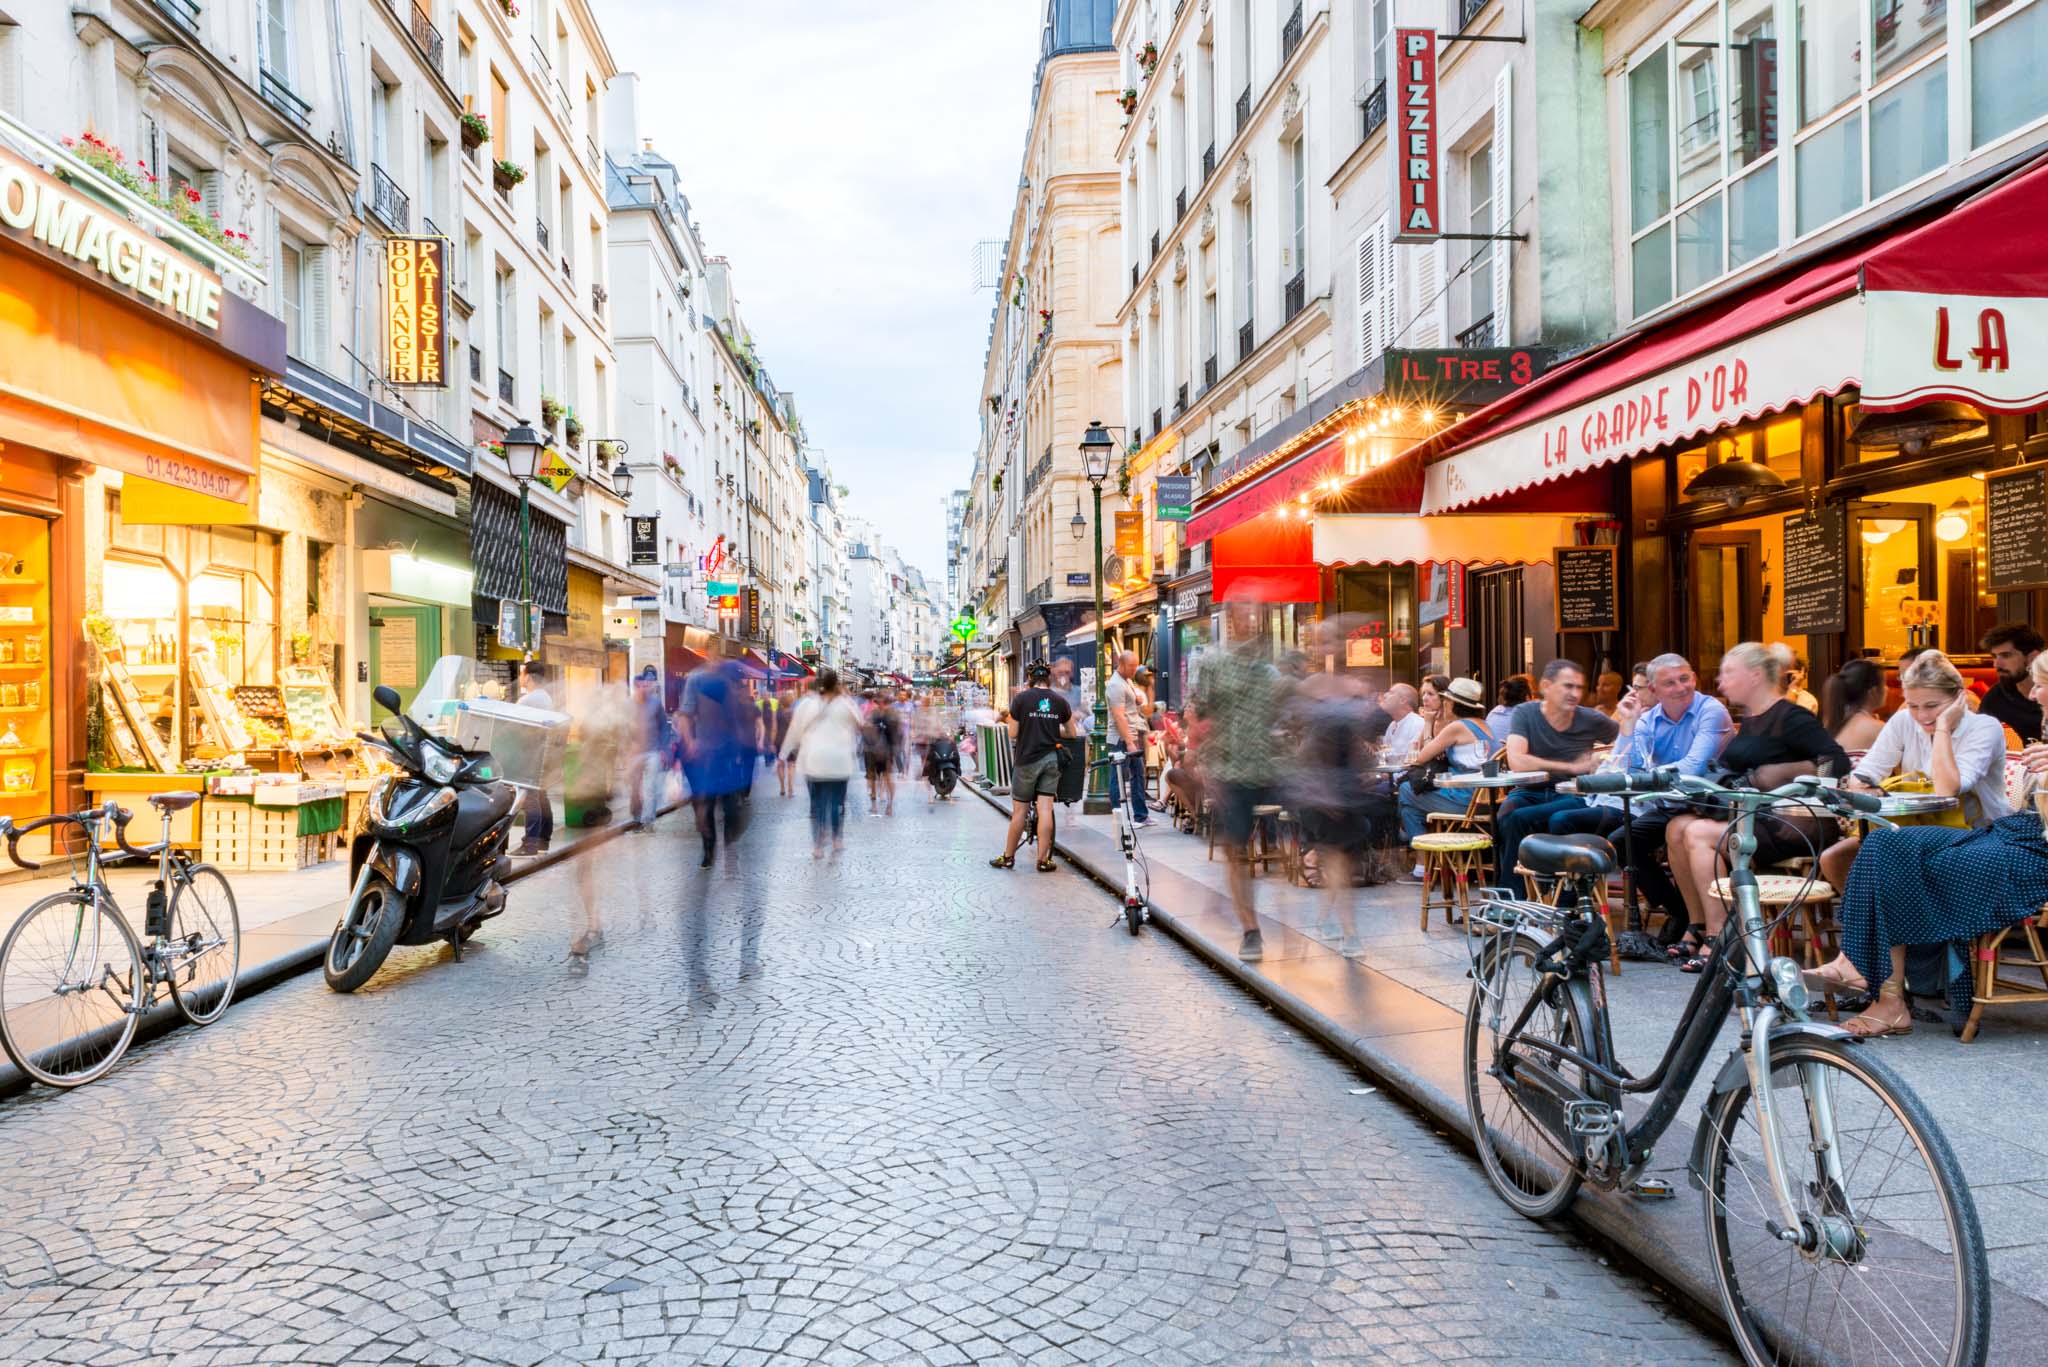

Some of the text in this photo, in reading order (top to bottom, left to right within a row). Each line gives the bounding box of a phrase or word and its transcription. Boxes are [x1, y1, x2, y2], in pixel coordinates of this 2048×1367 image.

[1406, 35, 1432, 229] PIZZERIA
[391, 242, 410, 381] BOULANGER
[418, 242, 440, 382] PATISSIER
[1932, 306, 2009, 373] LA
[1401, 351, 1532, 385] IL TRE 3
[1544, 358, 1747, 468] LA GRAPPE D'OR
[146, 455, 230, 494] 01.42.33.04.07
